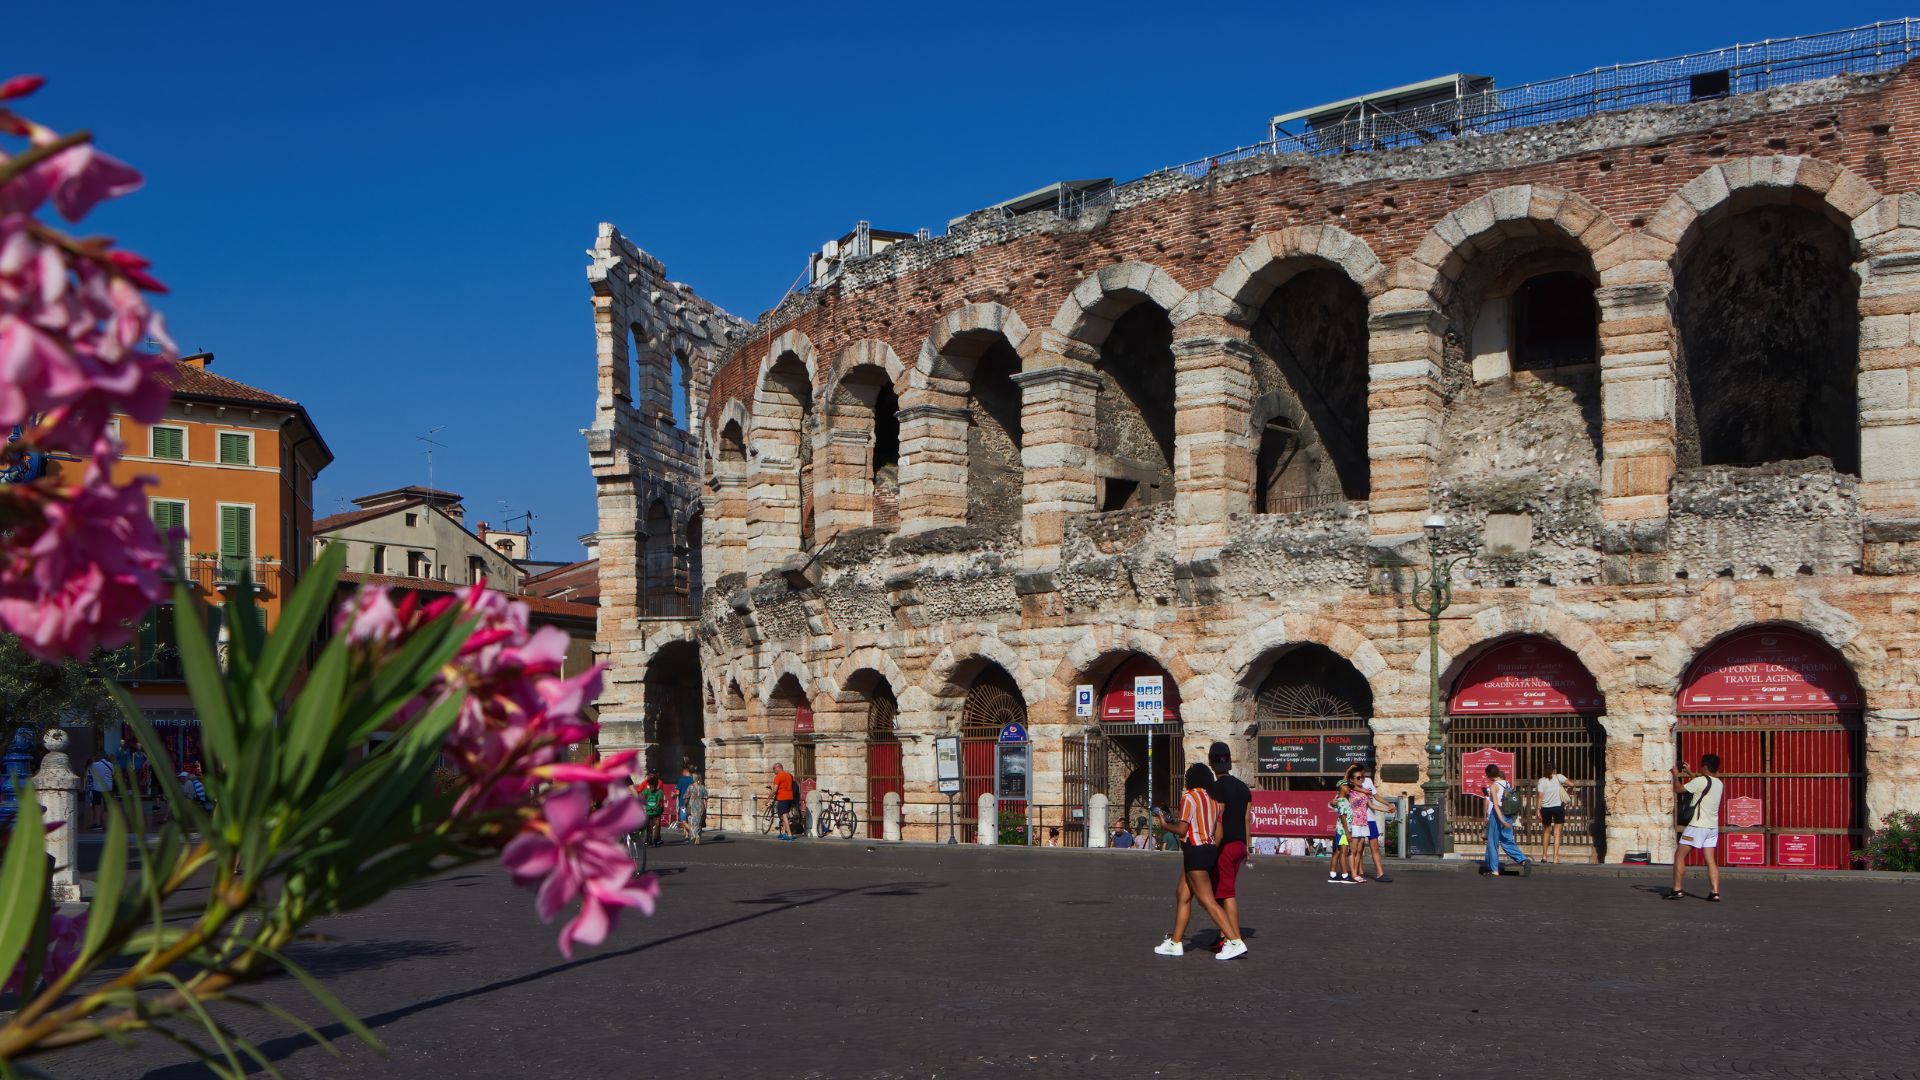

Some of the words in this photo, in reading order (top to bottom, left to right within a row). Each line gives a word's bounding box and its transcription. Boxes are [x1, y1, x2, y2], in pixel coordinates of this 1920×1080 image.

[1704, 664, 1727, 673] INFO
[1729, 664, 1758, 673] POINT
[1765, 664, 1789, 673] LOST
[1801, 663, 1839, 673] FOUND
[1723, 675, 1764, 683] TRAVEL
[1766, 674, 1817, 683] AGENCIES
[1484, 680, 1530, 688] GRADINATA
[1531, 679, 1576, 688] NUMERATA
[1273, 737, 1319, 745] ANFITEATRO
[1325, 736, 1352, 744] ARENA
[1267, 806, 1274, 814] di
[1273, 803, 1309, 815] Verona
[1279, 814, 1318, 827] Festival
